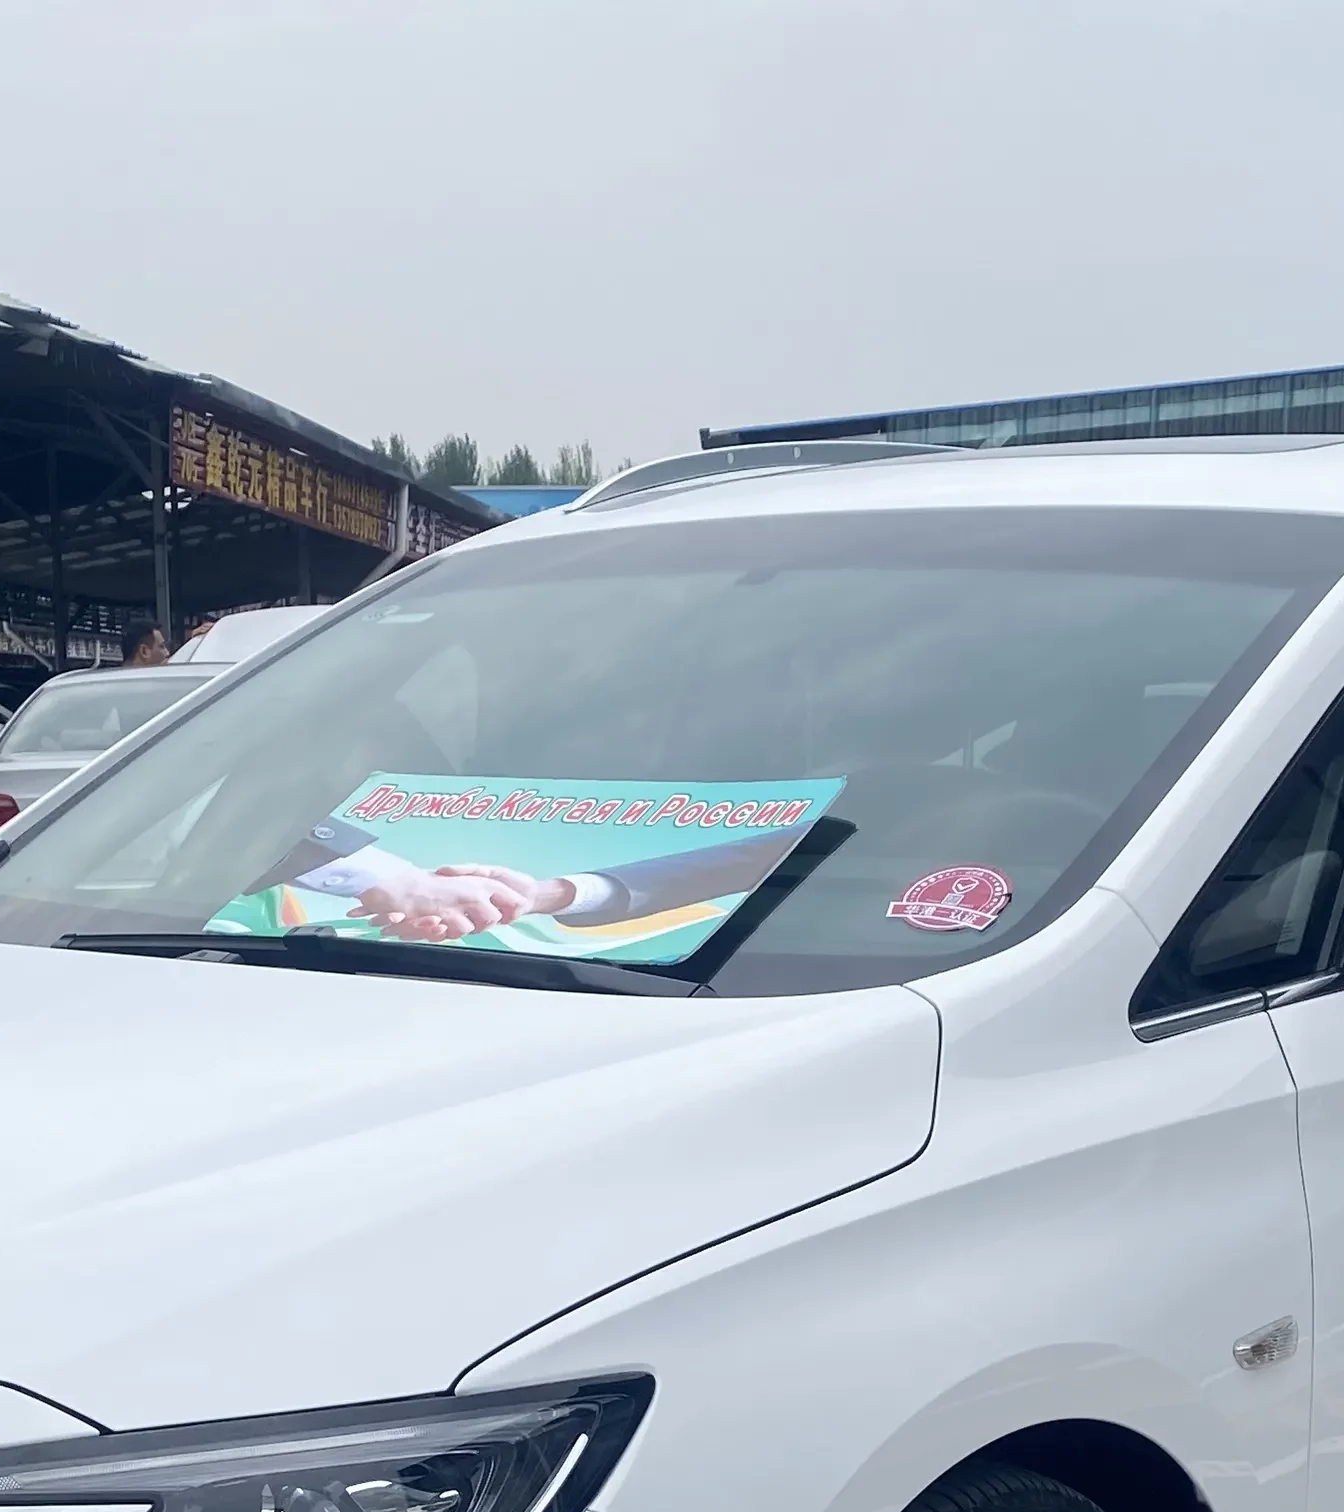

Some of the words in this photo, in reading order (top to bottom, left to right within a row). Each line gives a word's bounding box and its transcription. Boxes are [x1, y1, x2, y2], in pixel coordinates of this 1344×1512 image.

[344, 784, 498, 823] Дружба
[488, 789, 624, 824] Китая
[615, 799, 654, 826] и
[644, 794, 813, 828] России
